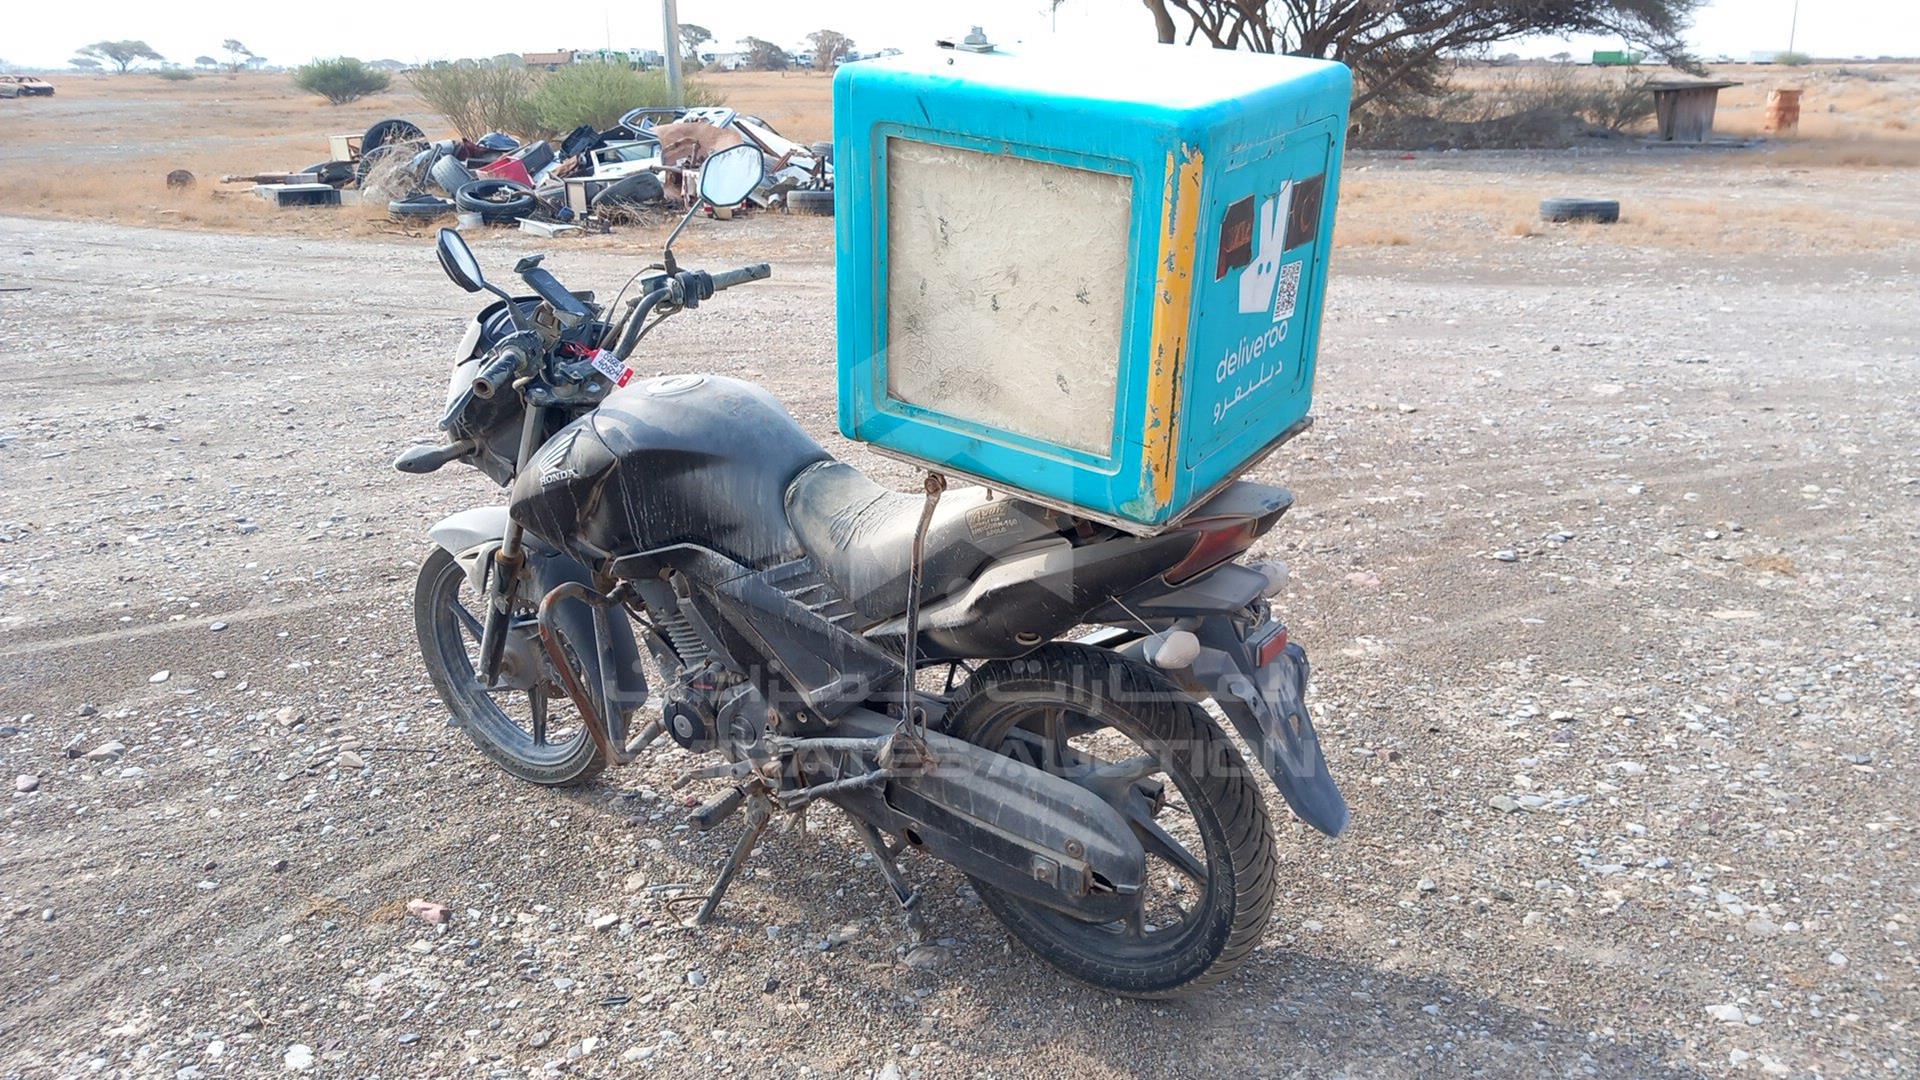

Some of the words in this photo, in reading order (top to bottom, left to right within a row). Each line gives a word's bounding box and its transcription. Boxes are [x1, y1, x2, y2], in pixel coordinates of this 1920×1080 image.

[1216, 320, 1288, 384] deliveroo
[1213, 360, 1283, 425] ديليفرو
[539, 469, 579, 486] HONDA
